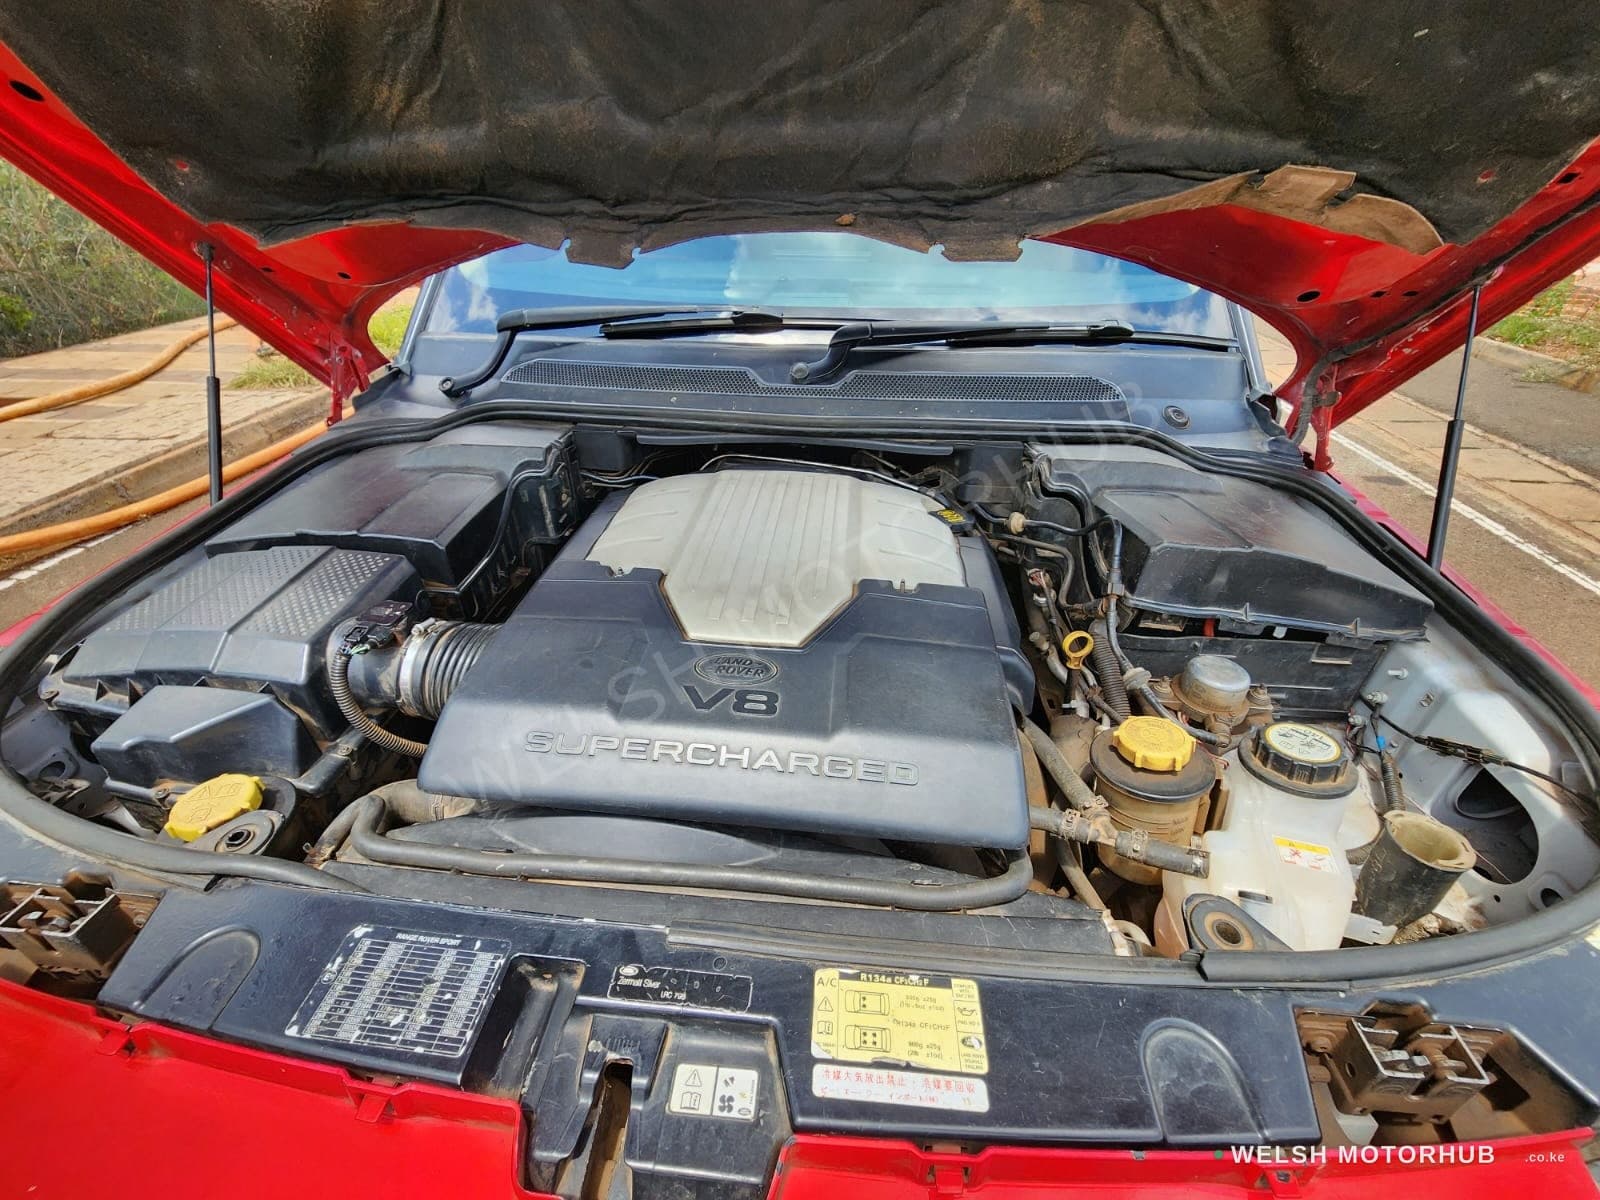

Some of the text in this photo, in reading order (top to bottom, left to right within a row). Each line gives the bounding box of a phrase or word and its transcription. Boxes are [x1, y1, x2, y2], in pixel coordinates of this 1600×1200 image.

[713, 656, 753, 666] LAND
[715, 665, 764, 677] ROVER
[681, 685, 779, 716] V8
[523, 729, 921, 787] SUPERCHARGED
[396, 933, 462, 946] RANGE ROVER SPORT
[617, 976, 642, 987] Zermatt
[816, 976, 837, 988] A/C
[860, 972, 892, 984] R134a
